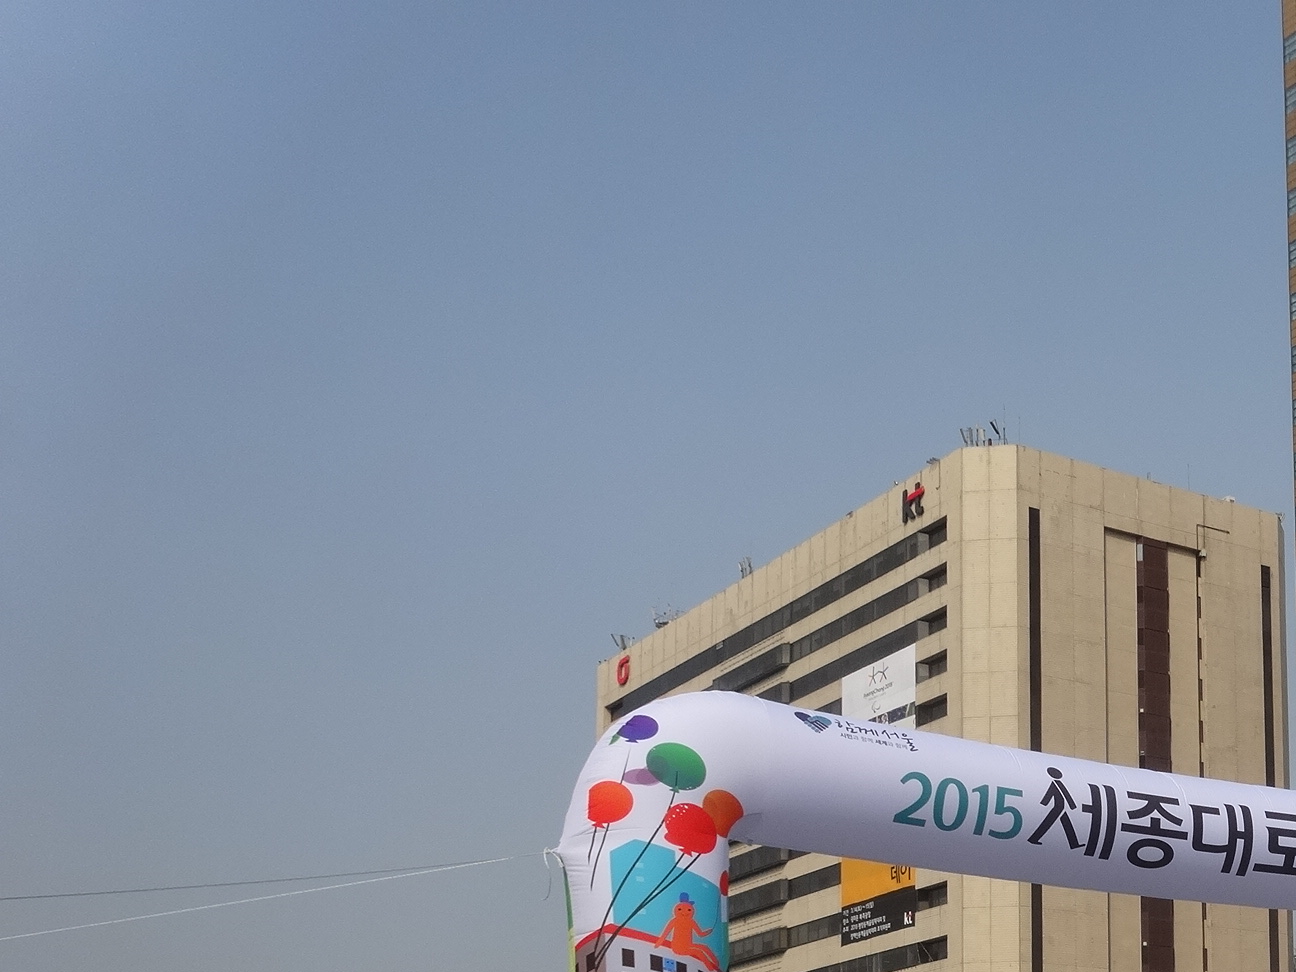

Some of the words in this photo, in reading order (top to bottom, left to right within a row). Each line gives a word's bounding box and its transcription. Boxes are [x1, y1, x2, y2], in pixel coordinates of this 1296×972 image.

[902, 481, 925, 524] kt
[834, 718, 879, 738] 함께
[881, 729, 919, 752] 서울
[893, 771, 1024, 840] 2015
[903, 911, 913, 925] kt
